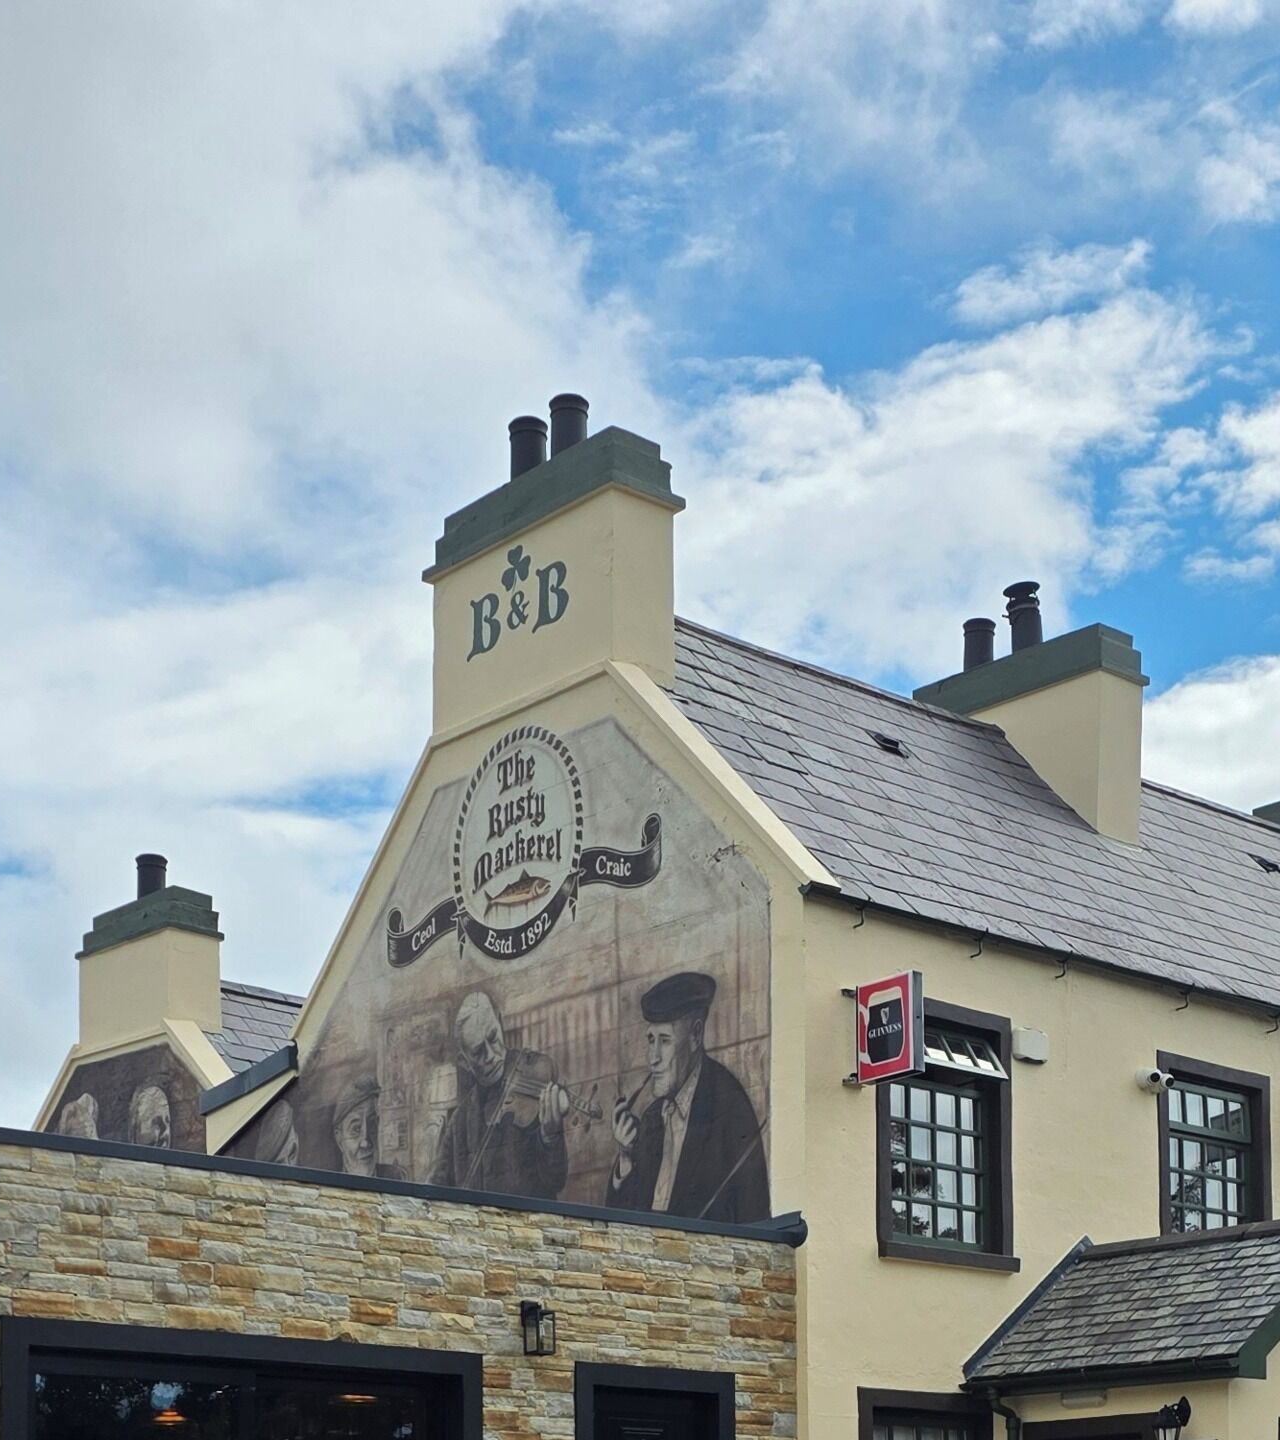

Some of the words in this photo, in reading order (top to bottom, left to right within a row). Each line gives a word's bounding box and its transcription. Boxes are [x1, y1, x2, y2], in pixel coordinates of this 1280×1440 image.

[497, 749, 535, 795] The
[487, 786, 545, 842] Rusty
[472, 828, 562, 894] Mackerel
[595, 856, 632, 877] Craic
[411, 925, 436, 952] Ceol
[484, 930, 516, 954] Estd.
[520, 912, 552, 951] 1892
[868, 1022, 902, 1039] GUINNESS
